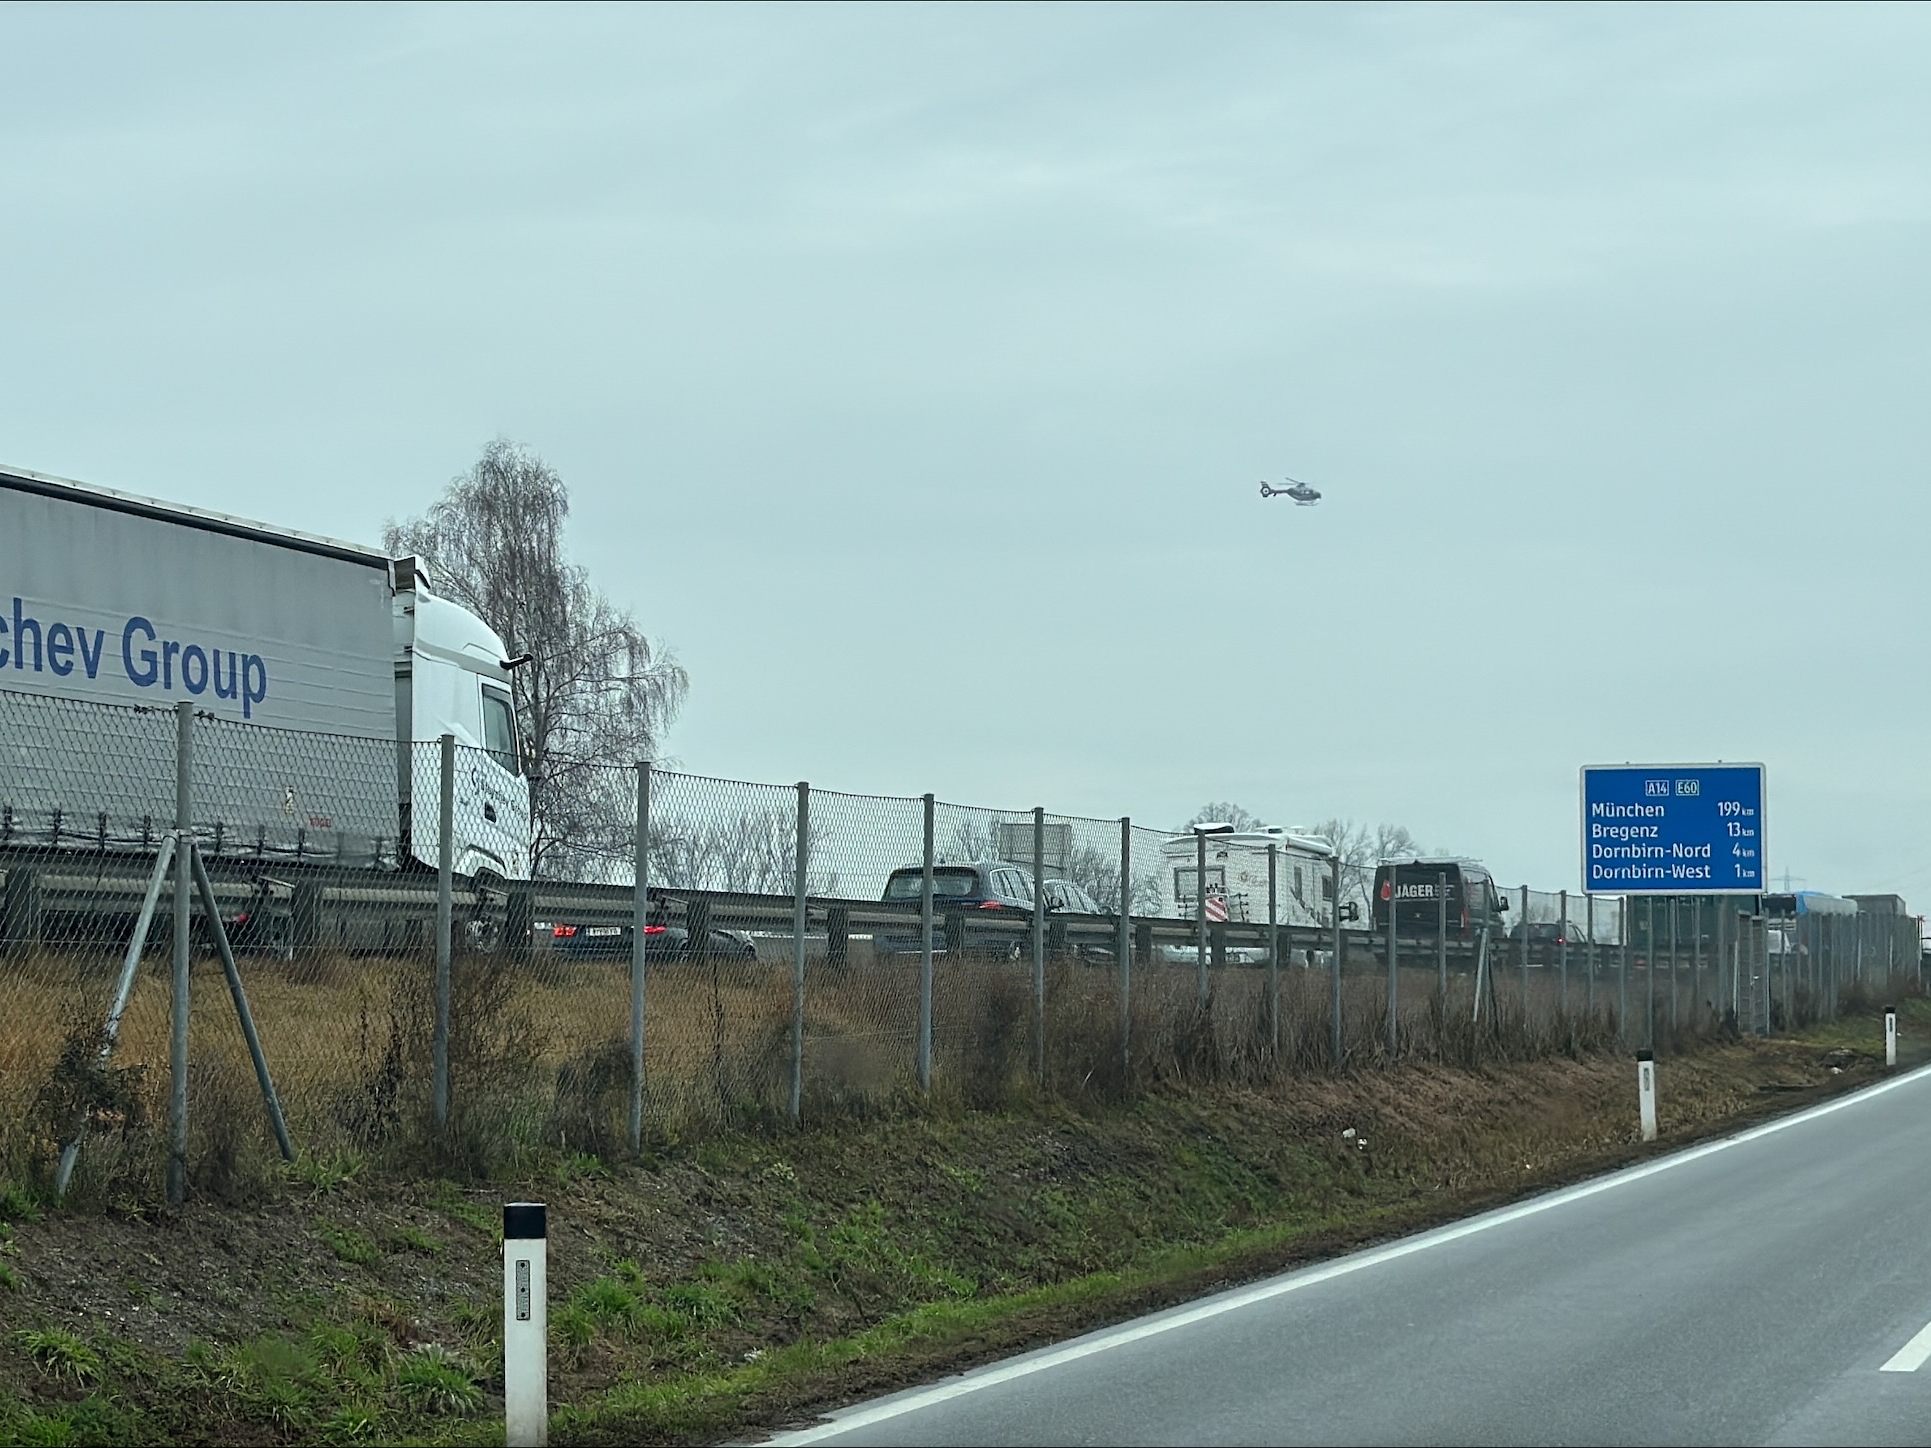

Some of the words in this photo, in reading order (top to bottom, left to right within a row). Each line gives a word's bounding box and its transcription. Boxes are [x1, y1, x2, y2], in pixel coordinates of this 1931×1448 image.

[122, 616, 267, 719] Group
[1648, 781, 1667, 795] A14
[1677, 781, 1698, 794] E60
[1591, 802, 1665, 817] München
[1717, 801, 1741, 817] 199
[1741, 807, 1754, 816] km
[1592, 823, 1658, 841] Bregenz
[1727, 821, 1741, 837] 13
[1741, 828, 1755, 837] km
[1592, 843, 1711, 859] Dornbirn-Nord
[1732, 842, 1742, 858] 4
[1742, 848, 1755, 858] km
[1592, 864, 1711, 880] Dornbirn-West
[1734, 863, 1741, 878] 1
[1742, 869, 1755, 878] km
